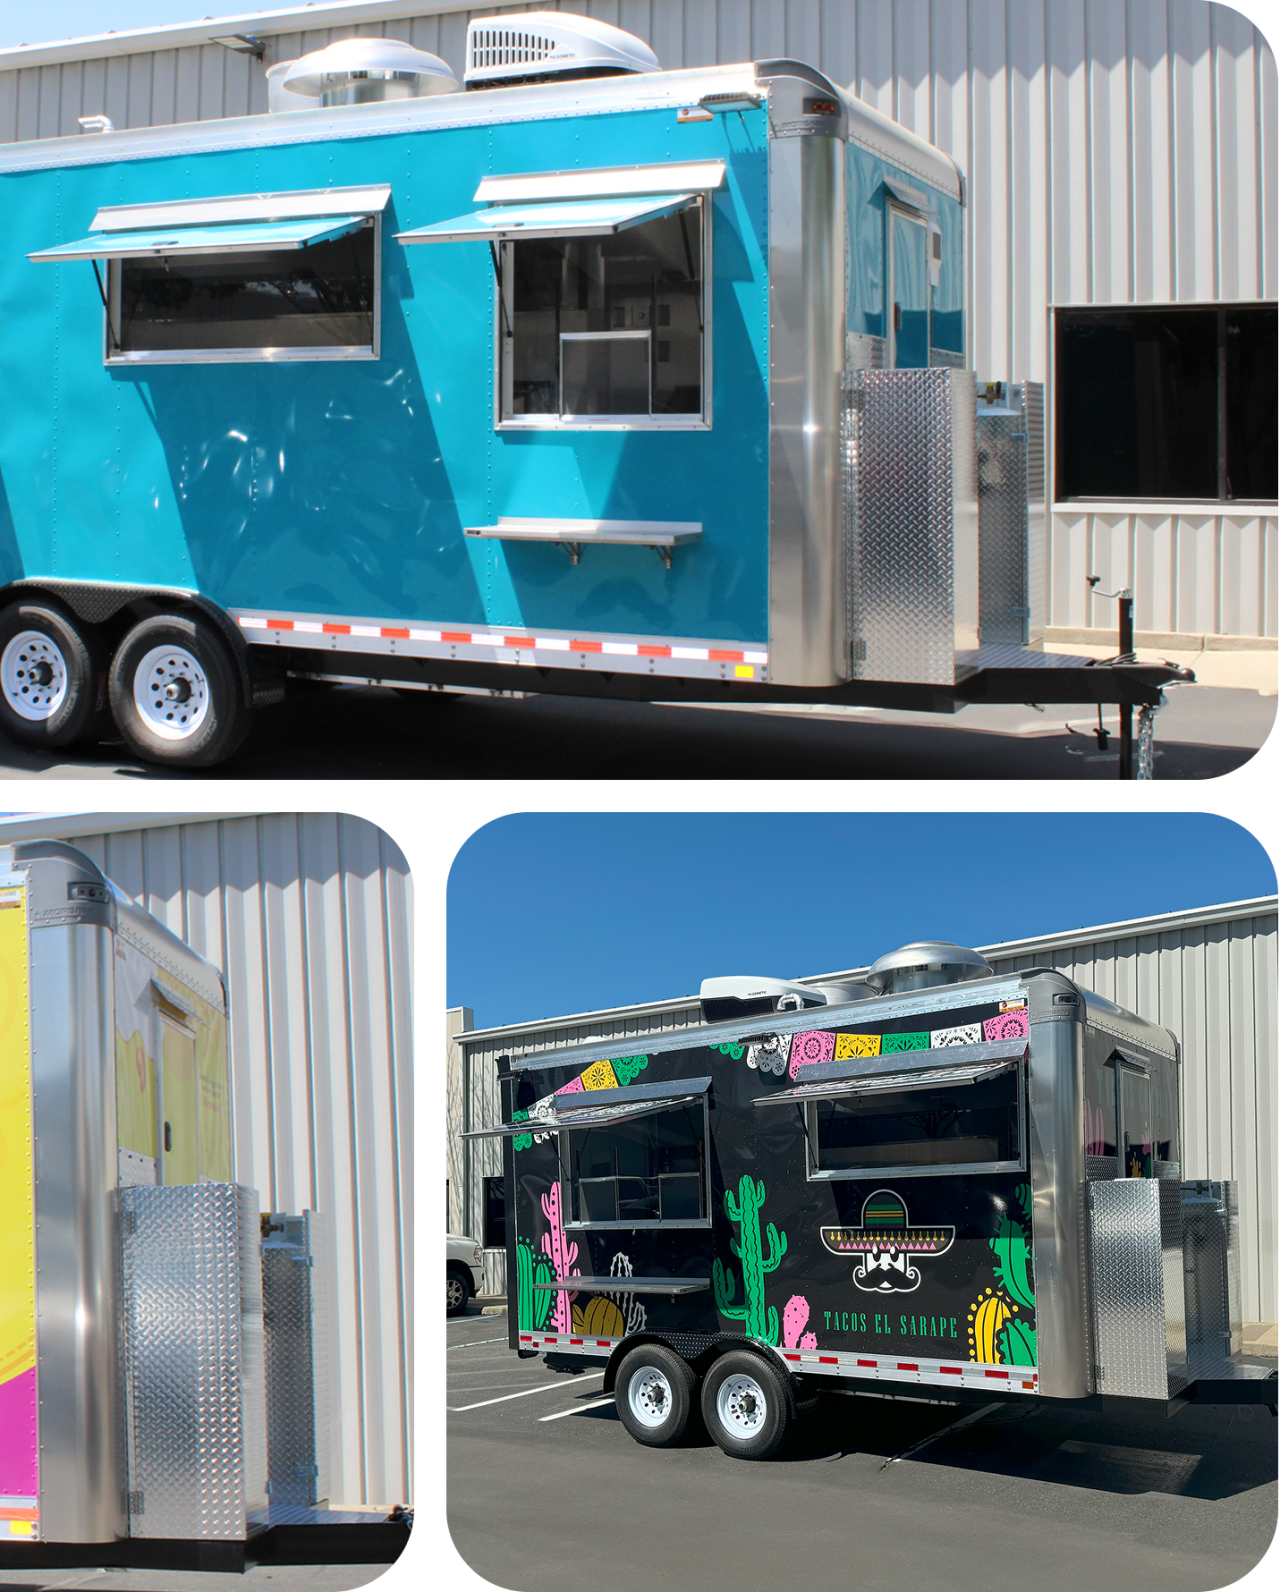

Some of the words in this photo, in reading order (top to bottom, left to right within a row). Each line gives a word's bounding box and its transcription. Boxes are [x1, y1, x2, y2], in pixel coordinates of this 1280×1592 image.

[823, 1311, 867, 1333] TACOS
[875, 1314, 891, 1334] EL
[900, 1315, 958, 1338] SARAPE
